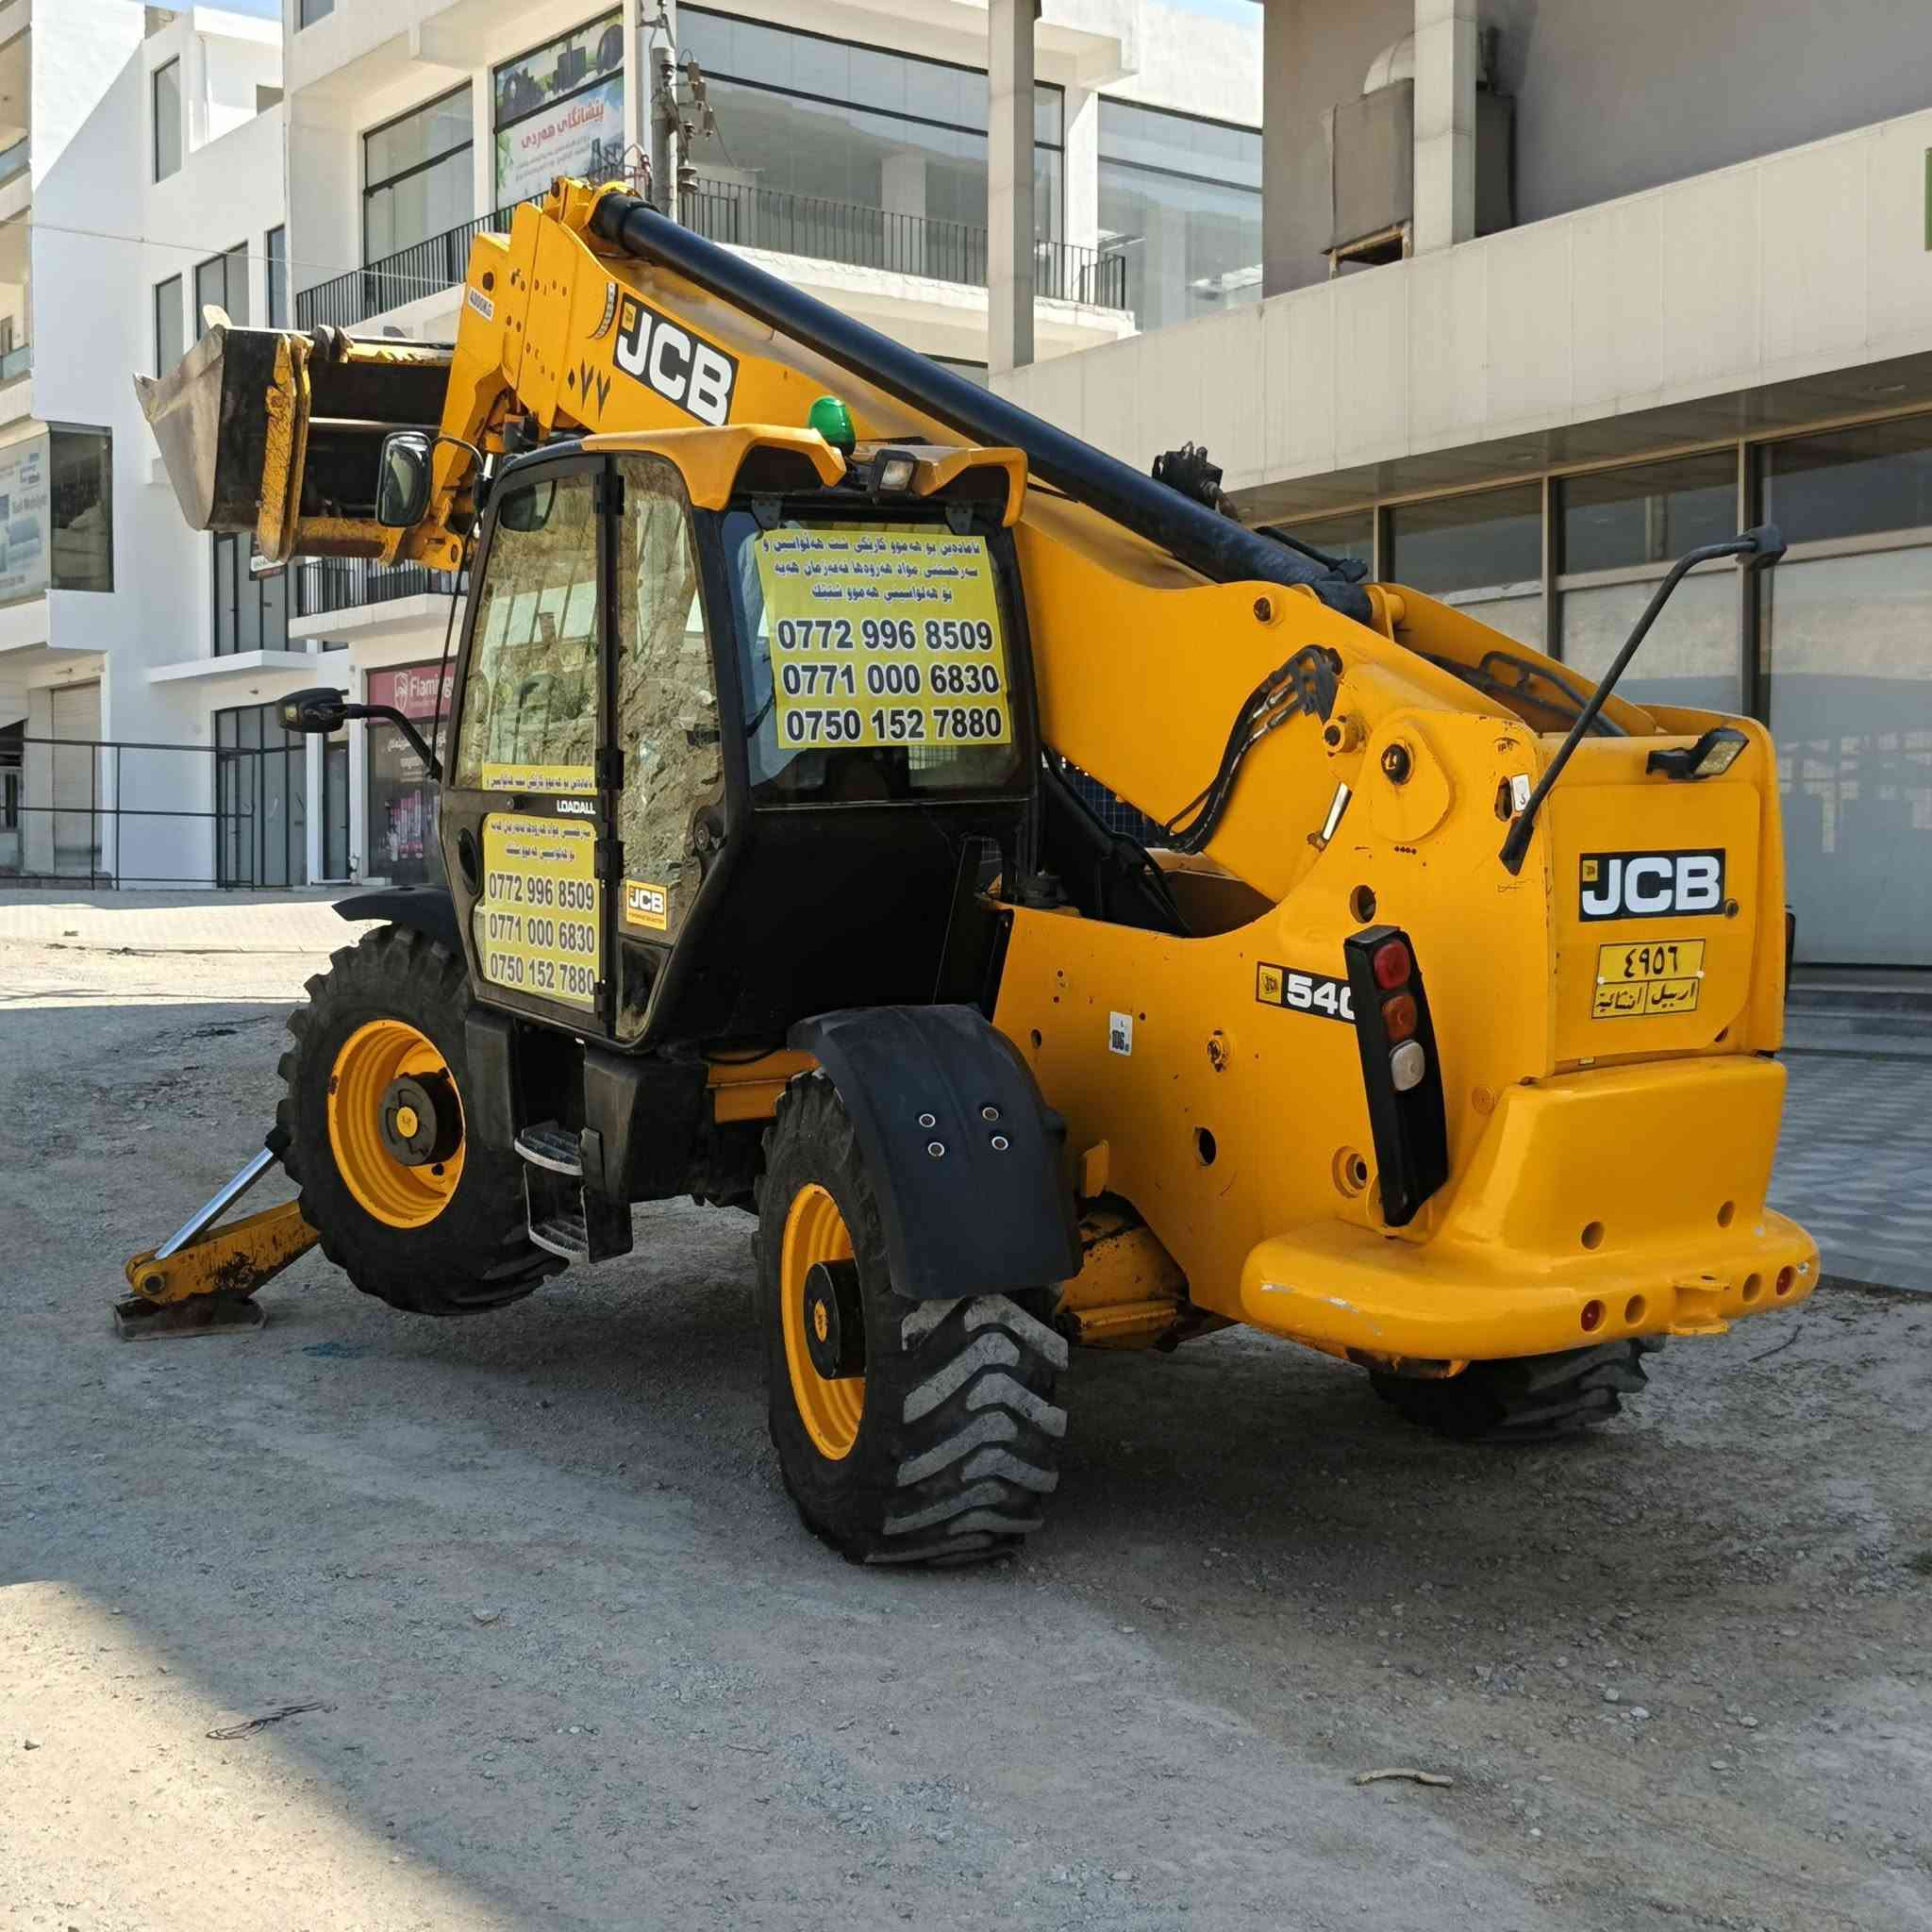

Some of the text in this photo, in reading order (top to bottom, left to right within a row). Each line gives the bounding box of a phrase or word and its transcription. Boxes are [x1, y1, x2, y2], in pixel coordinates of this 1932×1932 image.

[617, 311, 733, 426] JCB
[777, 619, 993, 651] 0772 996 8509
[783, 663, 1000, 694] 0771 000 6830
[787, 708, 1002, 741] 0750 152 7880
[557, 799, 596, 815] LOADALL
[489, 872, 594, 911] 0772 996 8509
[629, 888, 664, 913] JCB
[1581, 856, 1721, 916] JCB
[490, 913, 595, 953] 0771 000 6830
[490, 952, 595, 996] 0750 152 7880
[1623, 945, 1679, 978] ٤٩٥٦
